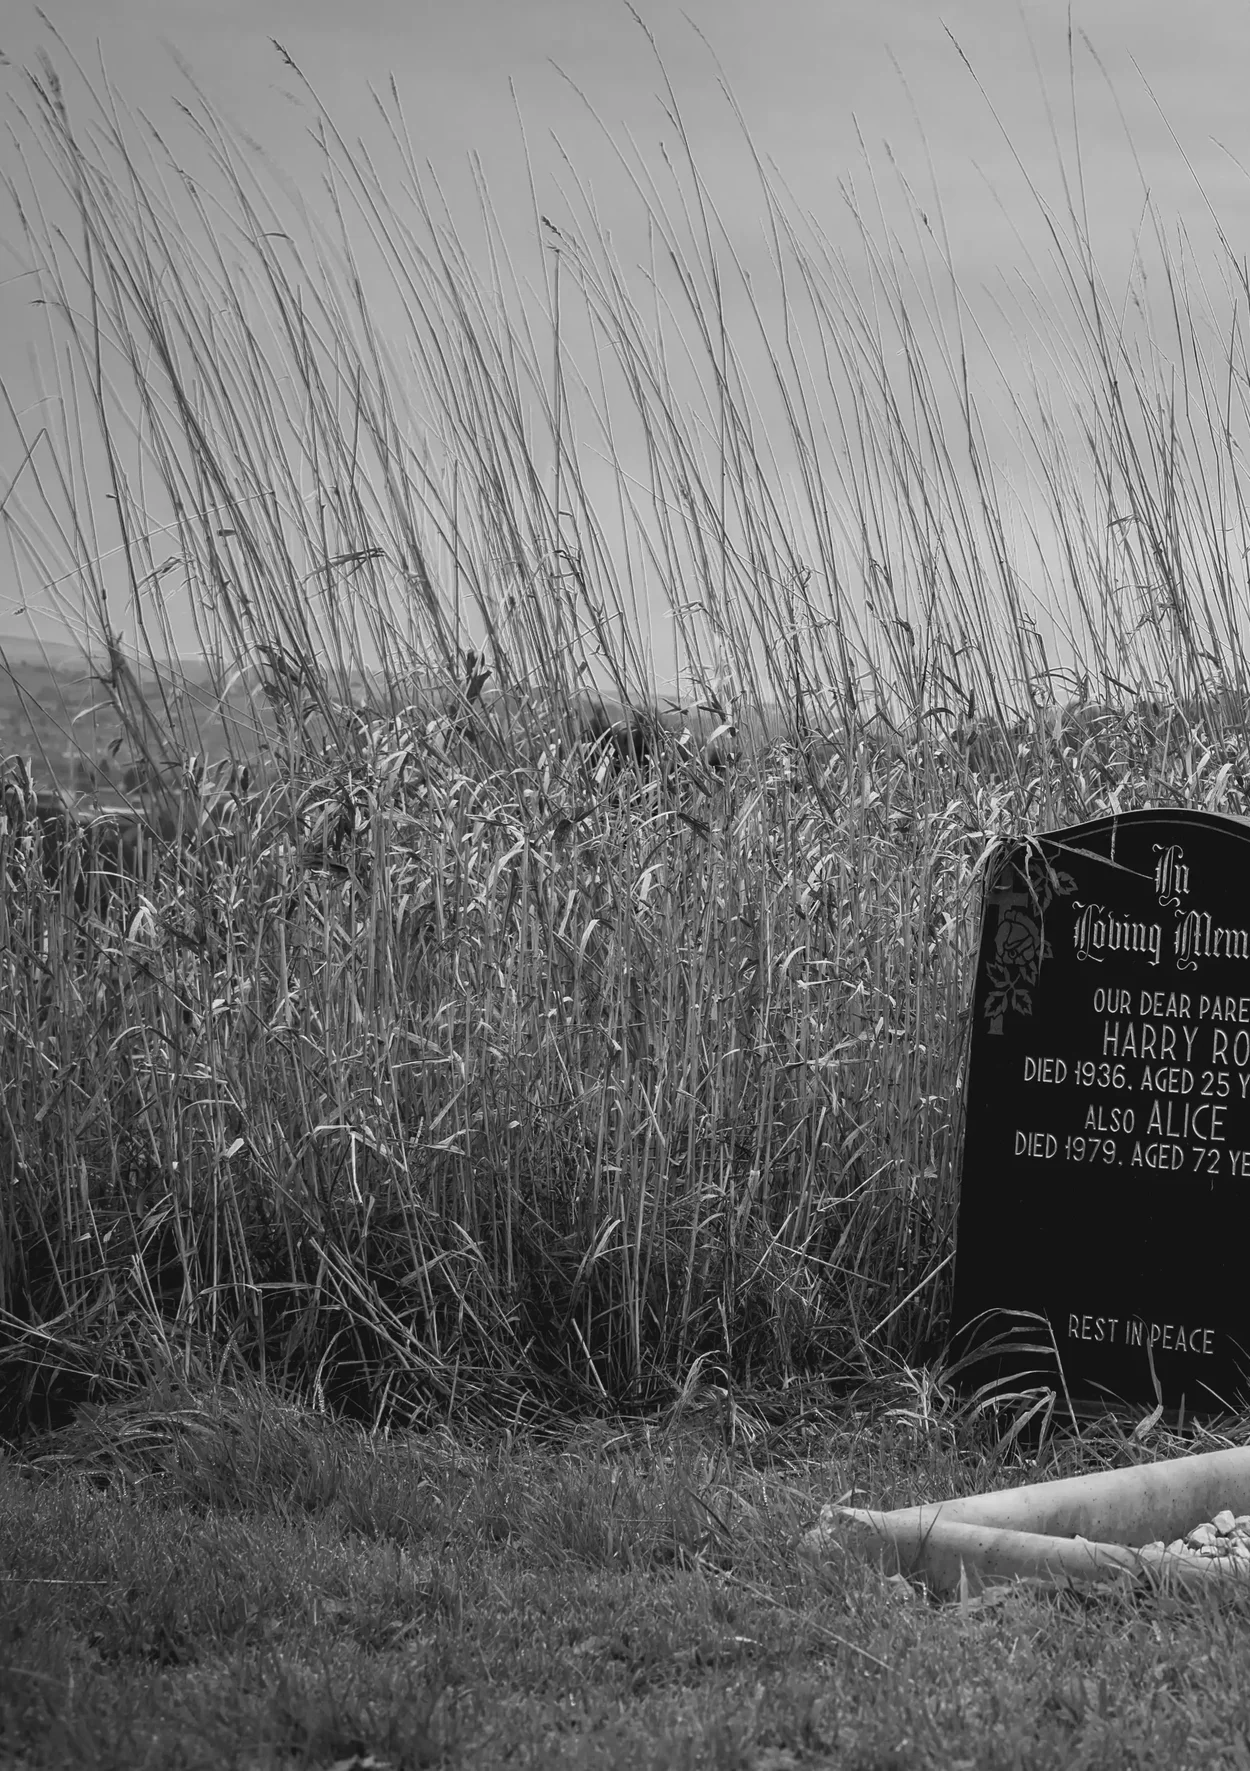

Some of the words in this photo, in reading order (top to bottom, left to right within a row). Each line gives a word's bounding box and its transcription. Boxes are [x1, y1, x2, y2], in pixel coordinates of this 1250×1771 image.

[1153, 843, 1190, 907] In
[1072, 902, 1162, 965] Loving
[1094, 989, 1132, 1015] OUR
[1140, 991, 1191, 1019] DEAR
[1102, 1020, 1199, 1063] HARRY
[1024, 1057, 1067, 1085] DIED
[1140, 1066, 1194, 1095] AGED
[1201, 1071, 1230, 1097] 25
[1084, 1104, 1135, 1134] ALSO
[1147, 1100, 1228, 1142] ALICE
[1014, 1130, 1058, 1159] DIED
[1130, 1140, 1185, 1171] AGED
[1192, 1147, 1220, 1174] 72
[1068, 1314, 1119, 1342] REST
[1125, 1320, 1143, 1346] IN
[1149, 1323, 1216, 1355] PEACE
